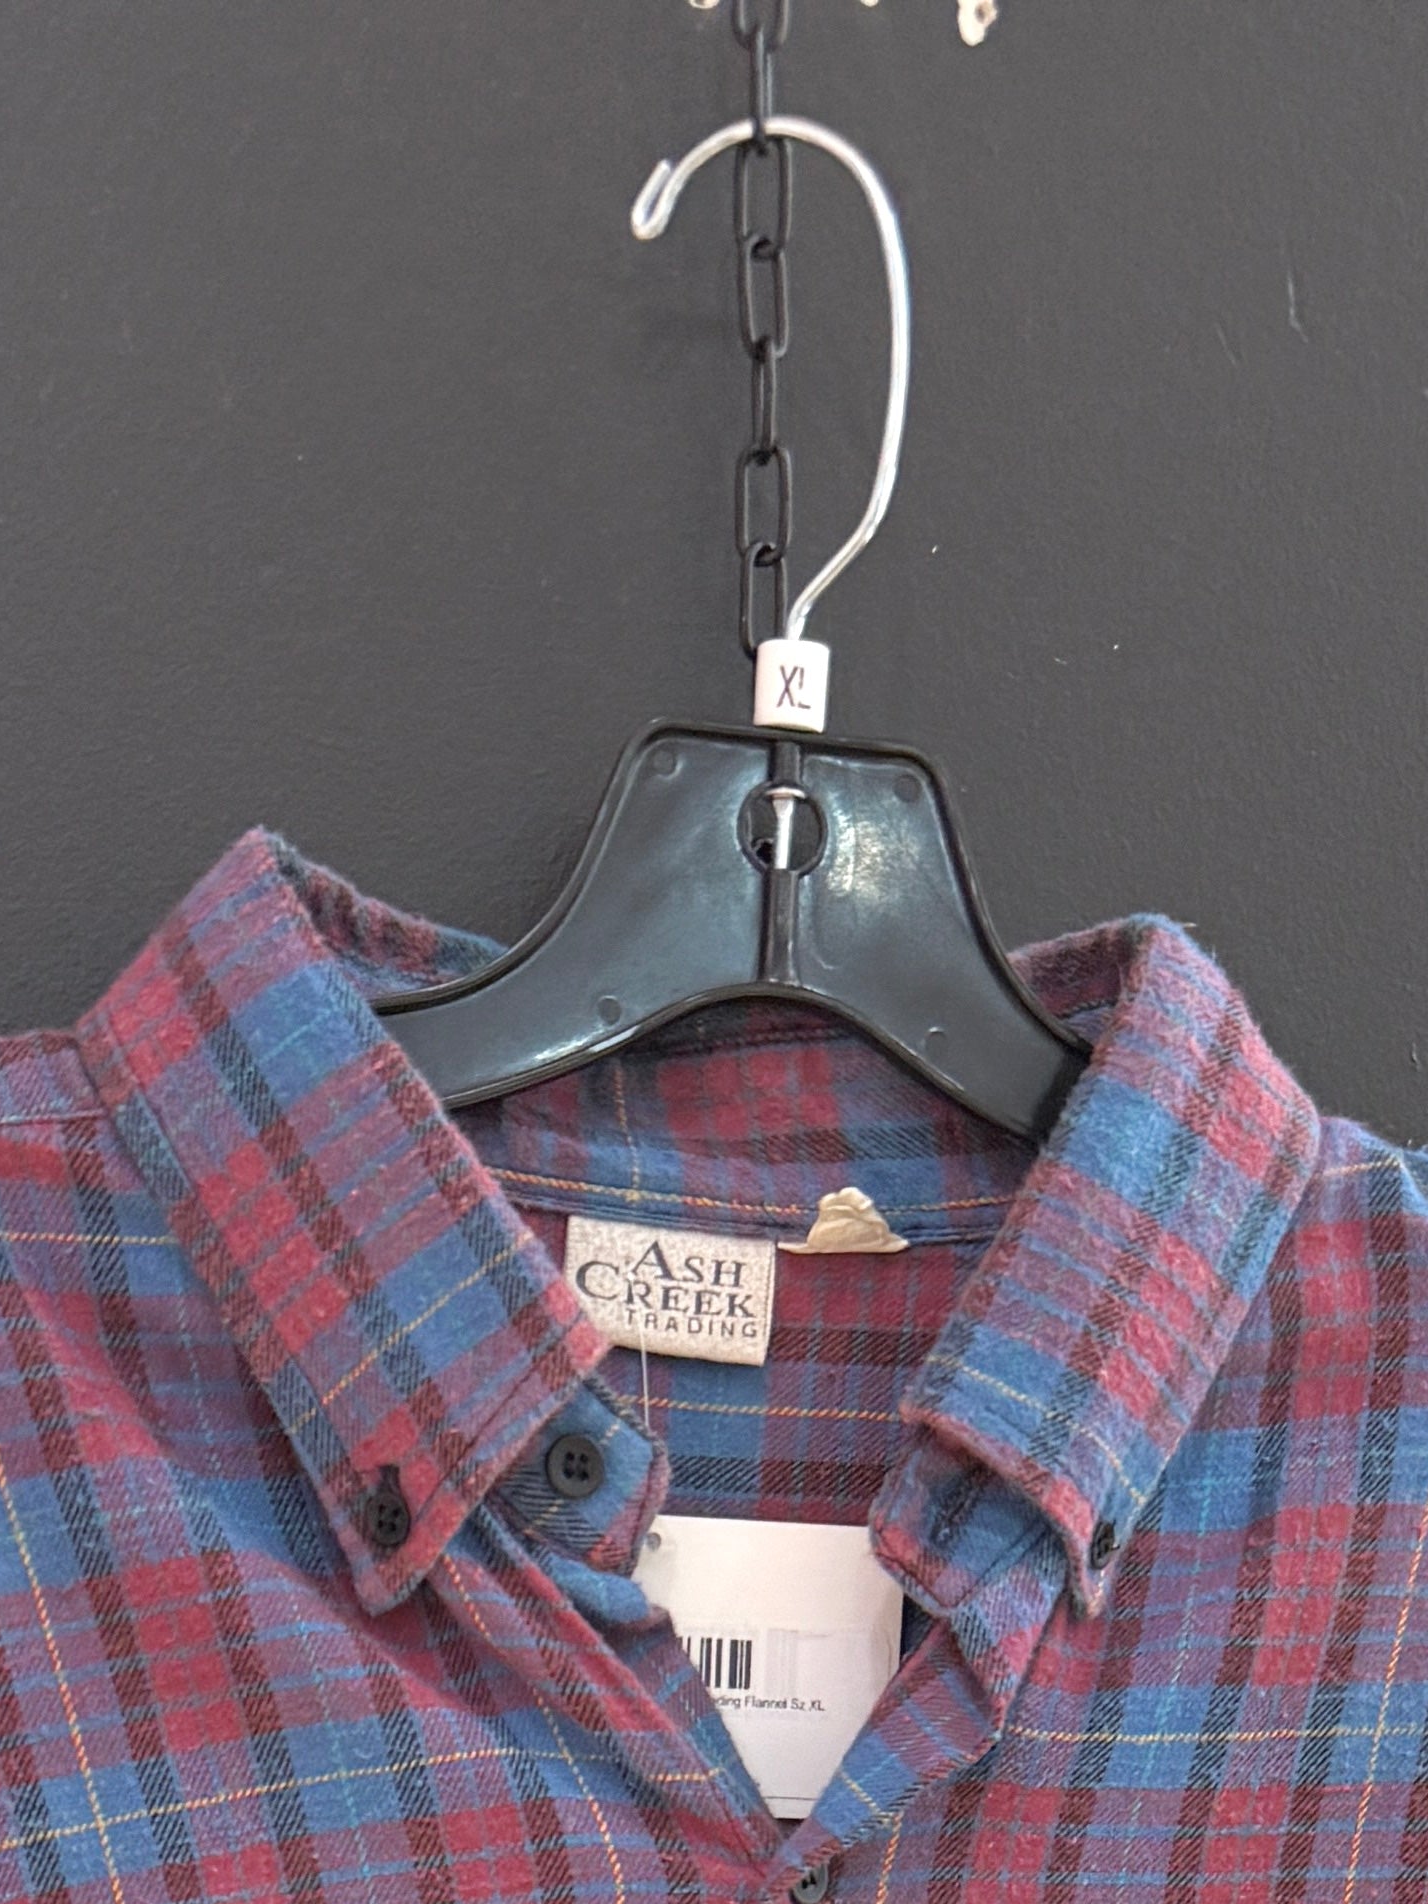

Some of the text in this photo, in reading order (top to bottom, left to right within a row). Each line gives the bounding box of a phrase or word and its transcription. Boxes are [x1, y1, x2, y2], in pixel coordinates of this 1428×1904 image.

[776, 665, 812, 708] XL
[632, 1240, 746, 1288] ASH
[575, 1260, 756, 1319] CREEK
[625, 1307, 758, 1339] TRADING
[744, 1695, 788, 1709] Flannel
[790, 1699, 805, 1711] Sz
[808, 1700, 825, 1711] XL
